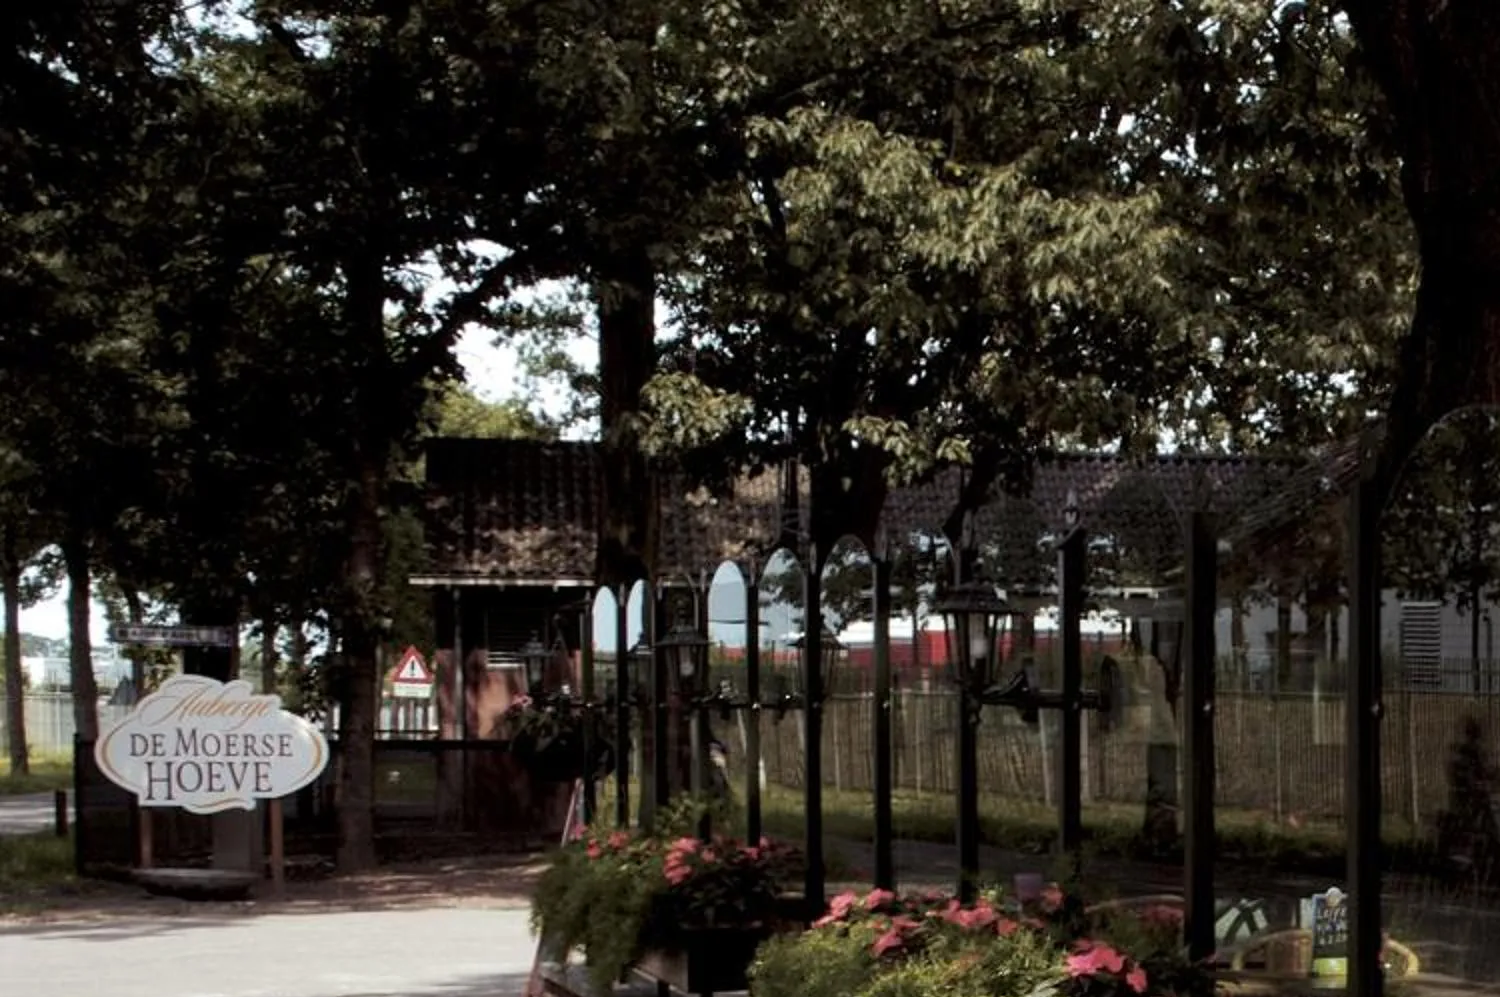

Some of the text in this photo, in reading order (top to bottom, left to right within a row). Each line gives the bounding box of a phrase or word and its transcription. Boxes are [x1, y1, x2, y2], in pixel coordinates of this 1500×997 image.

[139, 680, 271, 731] Auberge
[129, 728, 294, 757] DE MOERSE
[144, 761, 273, 801] HOEVE
